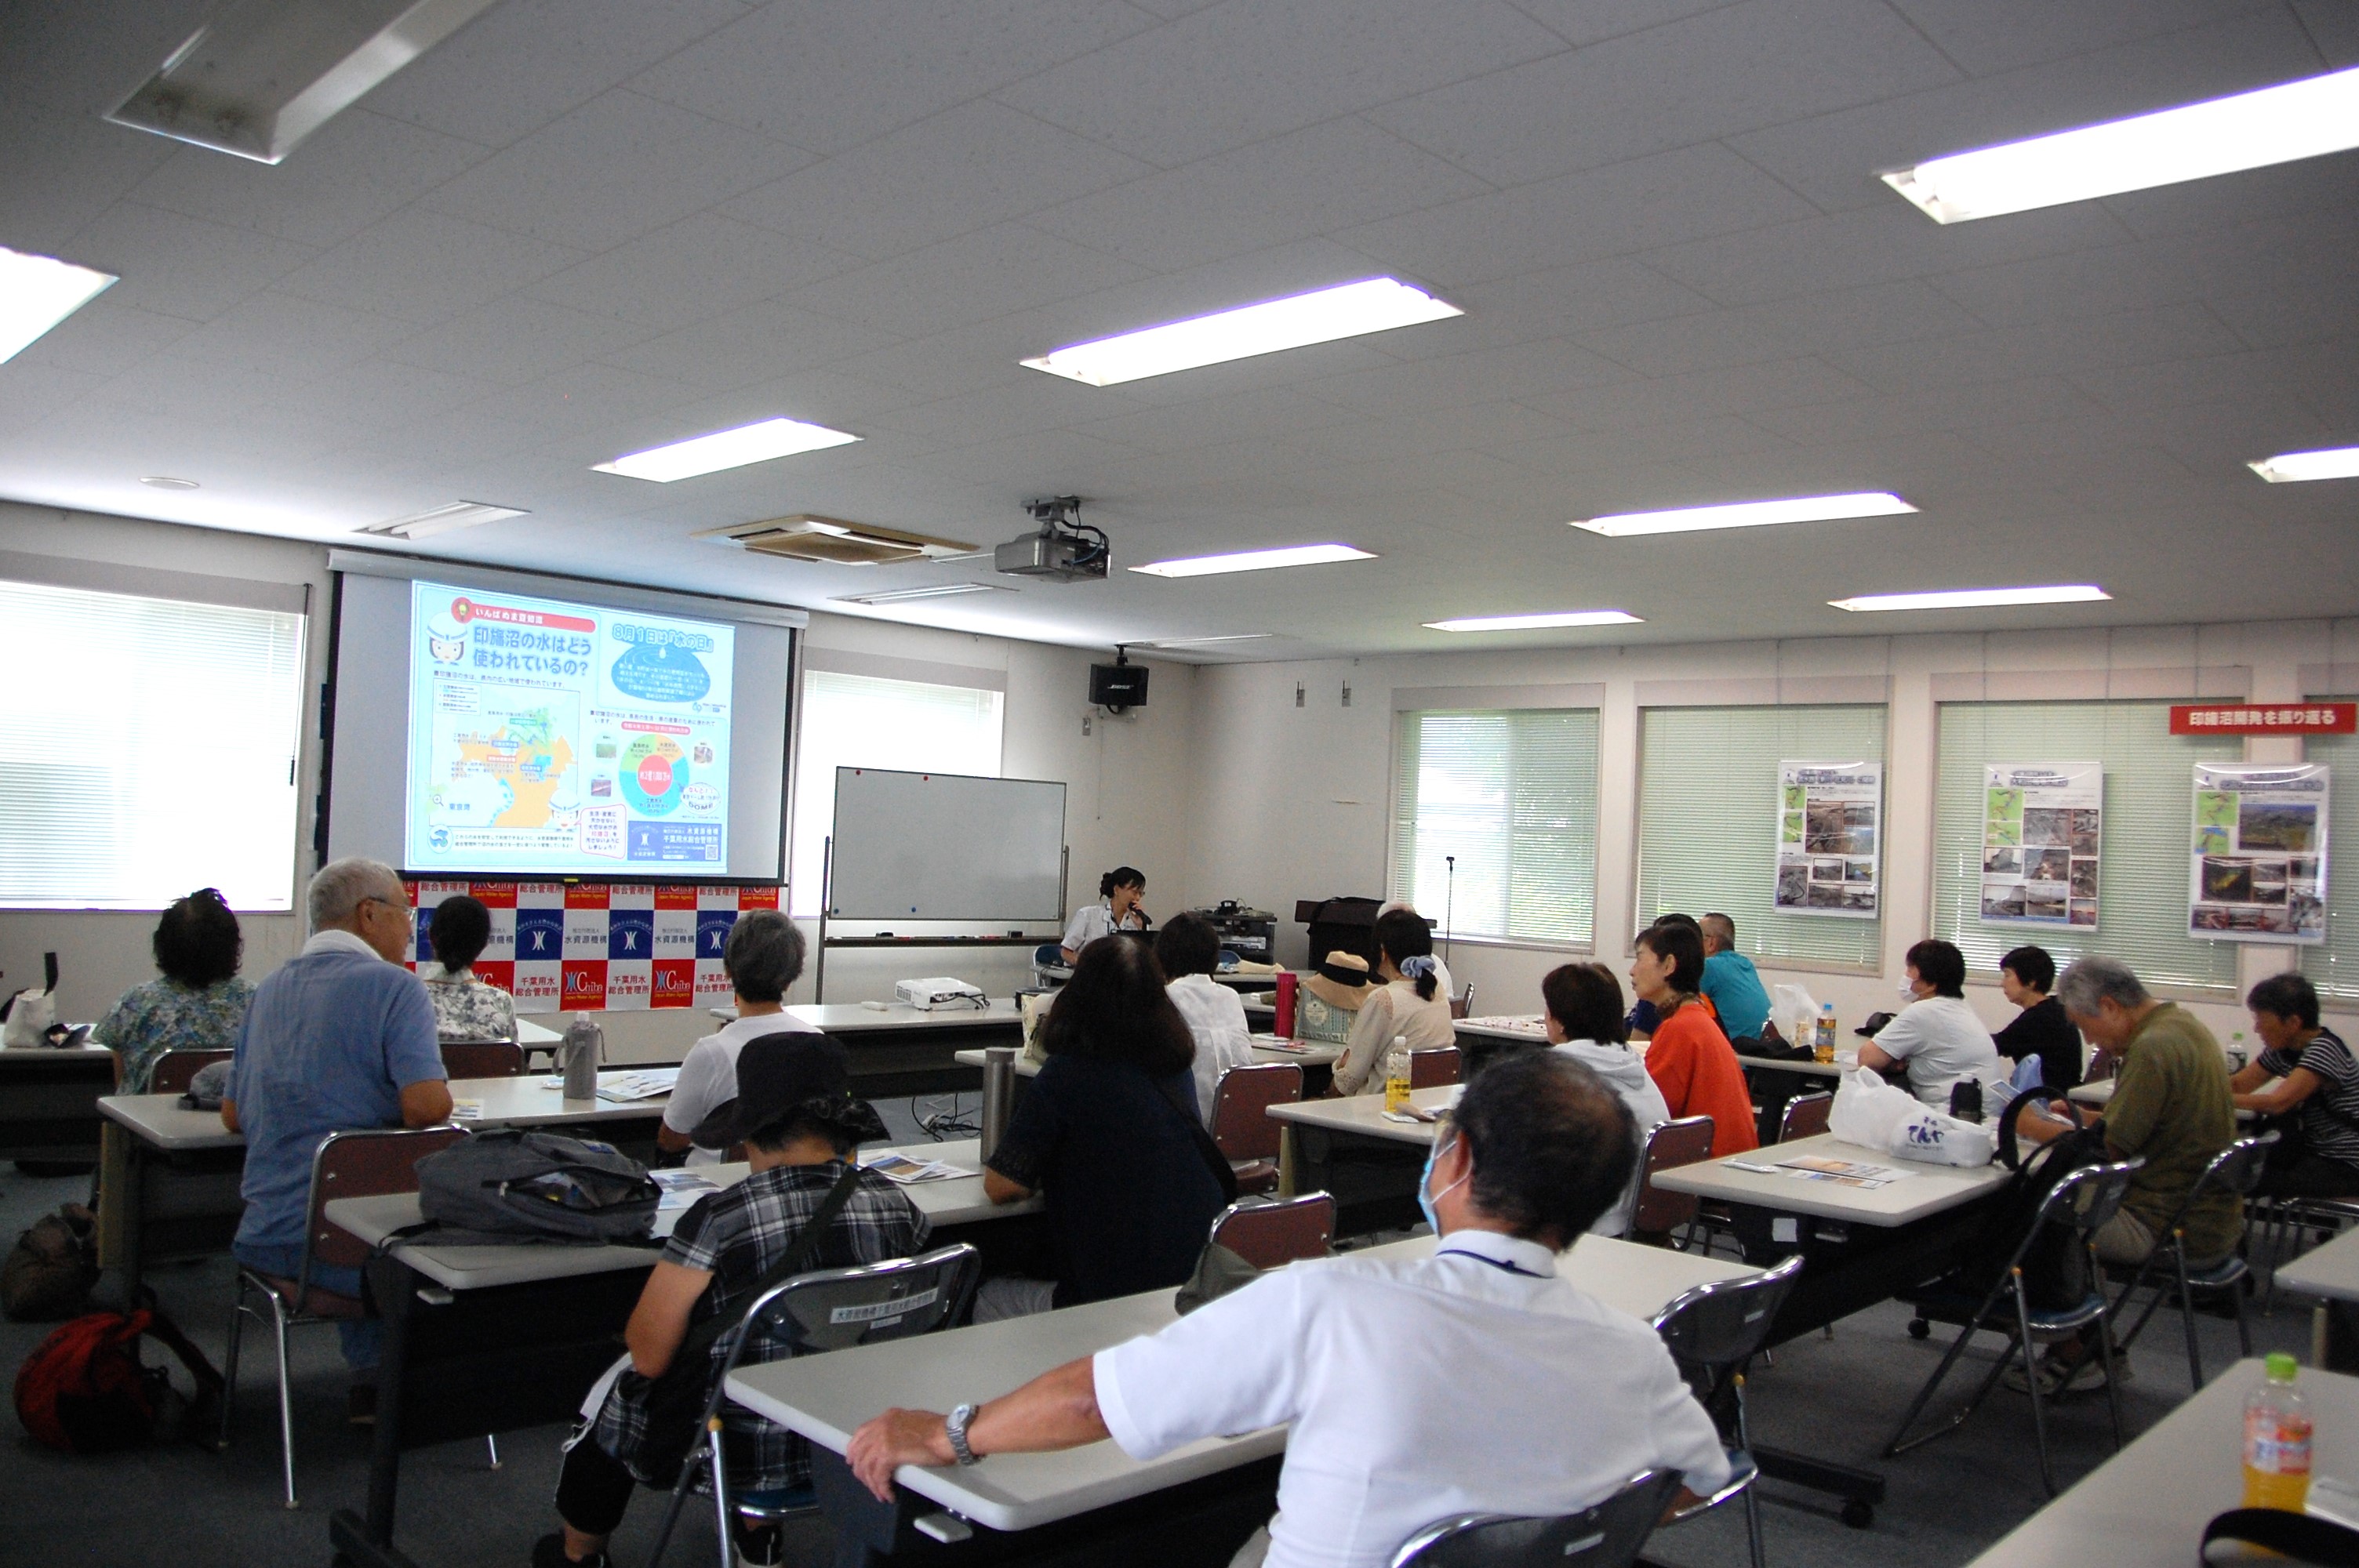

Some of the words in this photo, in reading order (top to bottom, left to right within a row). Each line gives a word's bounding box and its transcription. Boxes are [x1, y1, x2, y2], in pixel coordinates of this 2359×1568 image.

[475, 608, 543, 624] いんばぬま豆知識
[474, 626, 591, 655] 印旛沼の水はどう
[2190, 710, 2335, 726] 印旛沼開発を振り返る
[421, 882, 466, 891] 総合管理所
[612, 885, 652, 895] 総合管理所
[565, 935, 607, 944] 水資源機構
[655, 935, 695, 944] 水資源機構
[521, 976, 554, 985] 千葉用水
[577, 971, 603, 992] Chiba
[613, 975, 646, 984] 千葉用水
[667, 970, 691, 990] Chiba
[515, 987, 559, 996] 総合管理所
[609, 985, 649, 995] 総合管理所
[696, 983, 734, 993] 総合管理所
